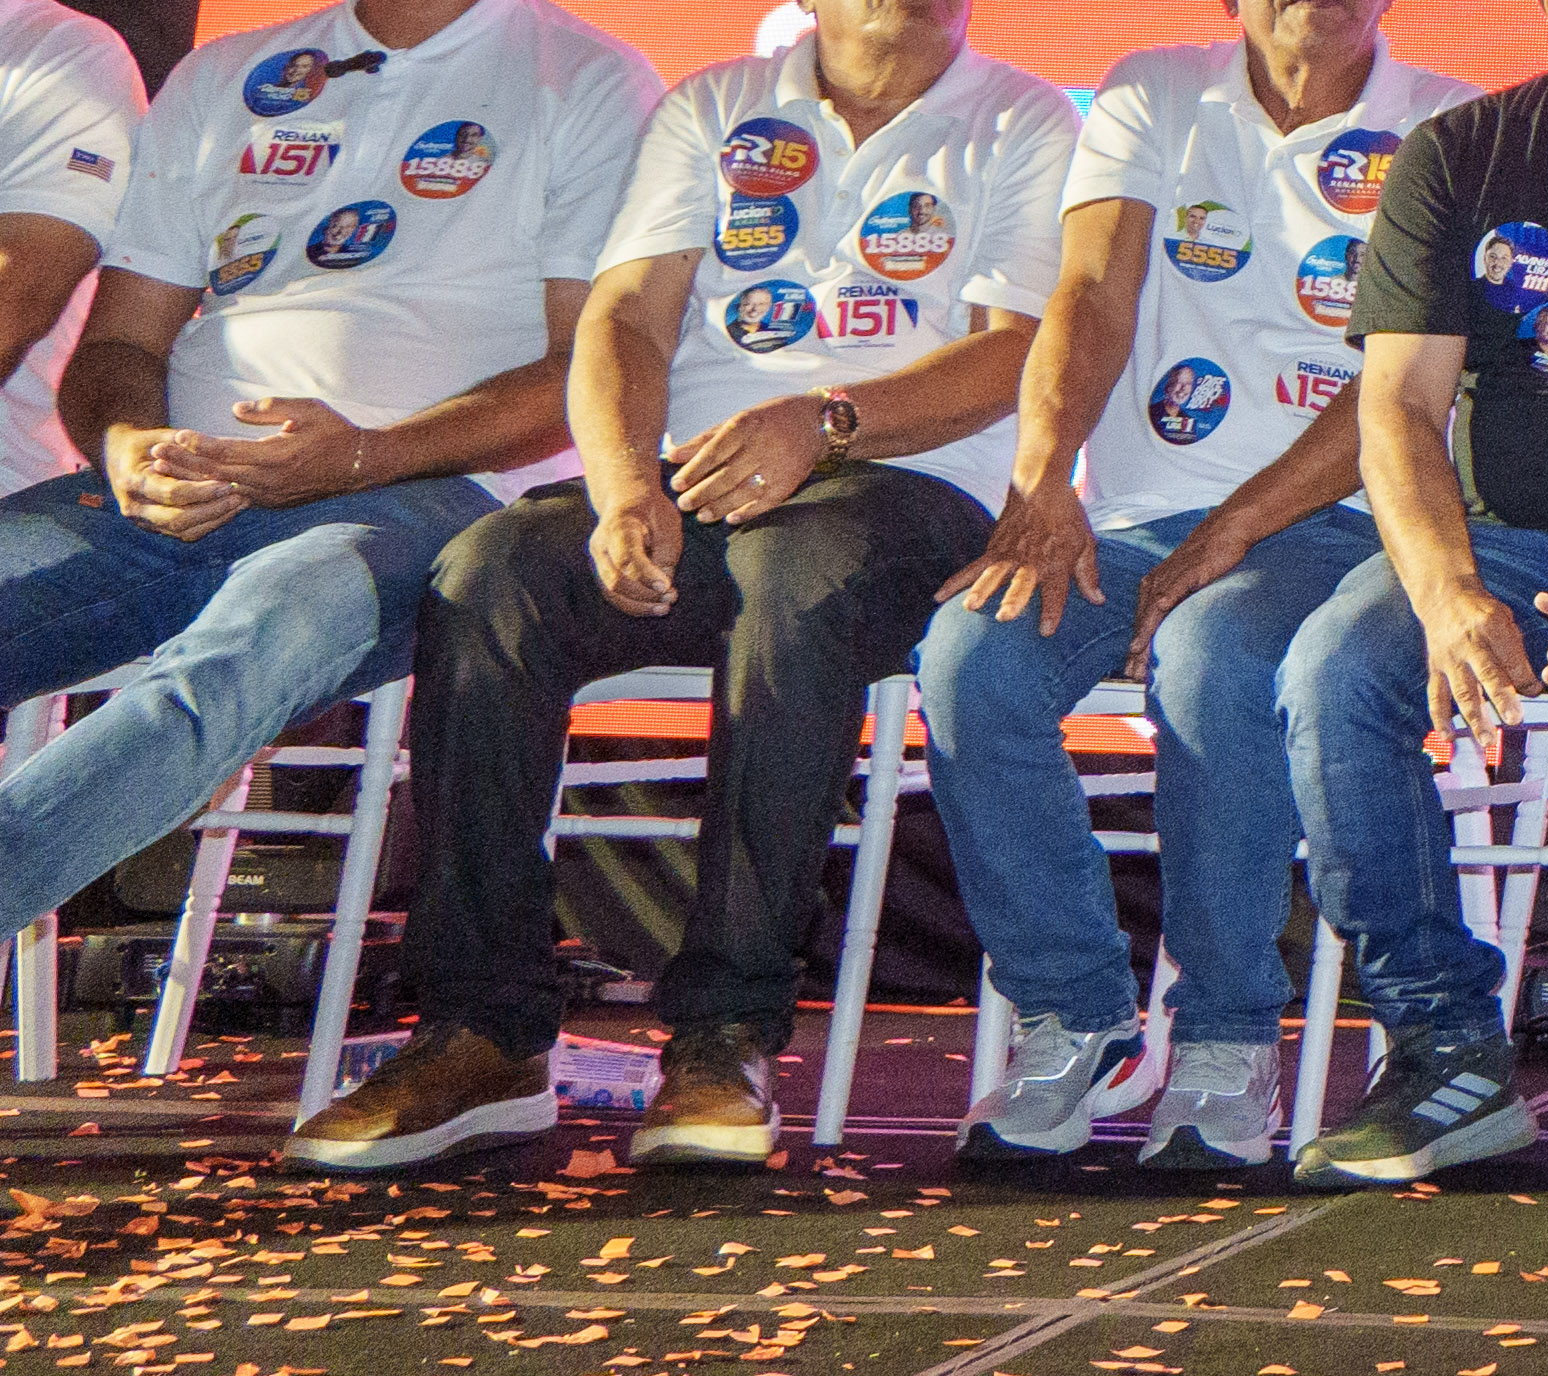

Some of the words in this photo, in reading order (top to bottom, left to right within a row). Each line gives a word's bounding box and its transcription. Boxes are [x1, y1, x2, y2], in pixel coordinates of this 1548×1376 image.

[259, 143, 325, 177] 151
[769, 138, 809, 170] 15
[403, 156, 488, 179] 15888
[721, 224, 787, 251] 5555
[865, 231, 951, 255] 15888
[1176, 241, 1238, 269] 5555
[837, 285, 898, 299] RENAN
[836, 298, 898, 338] 151
[1297, 359, 1356, 381] RENAN
[227, 874, 264, 886] BEAM
